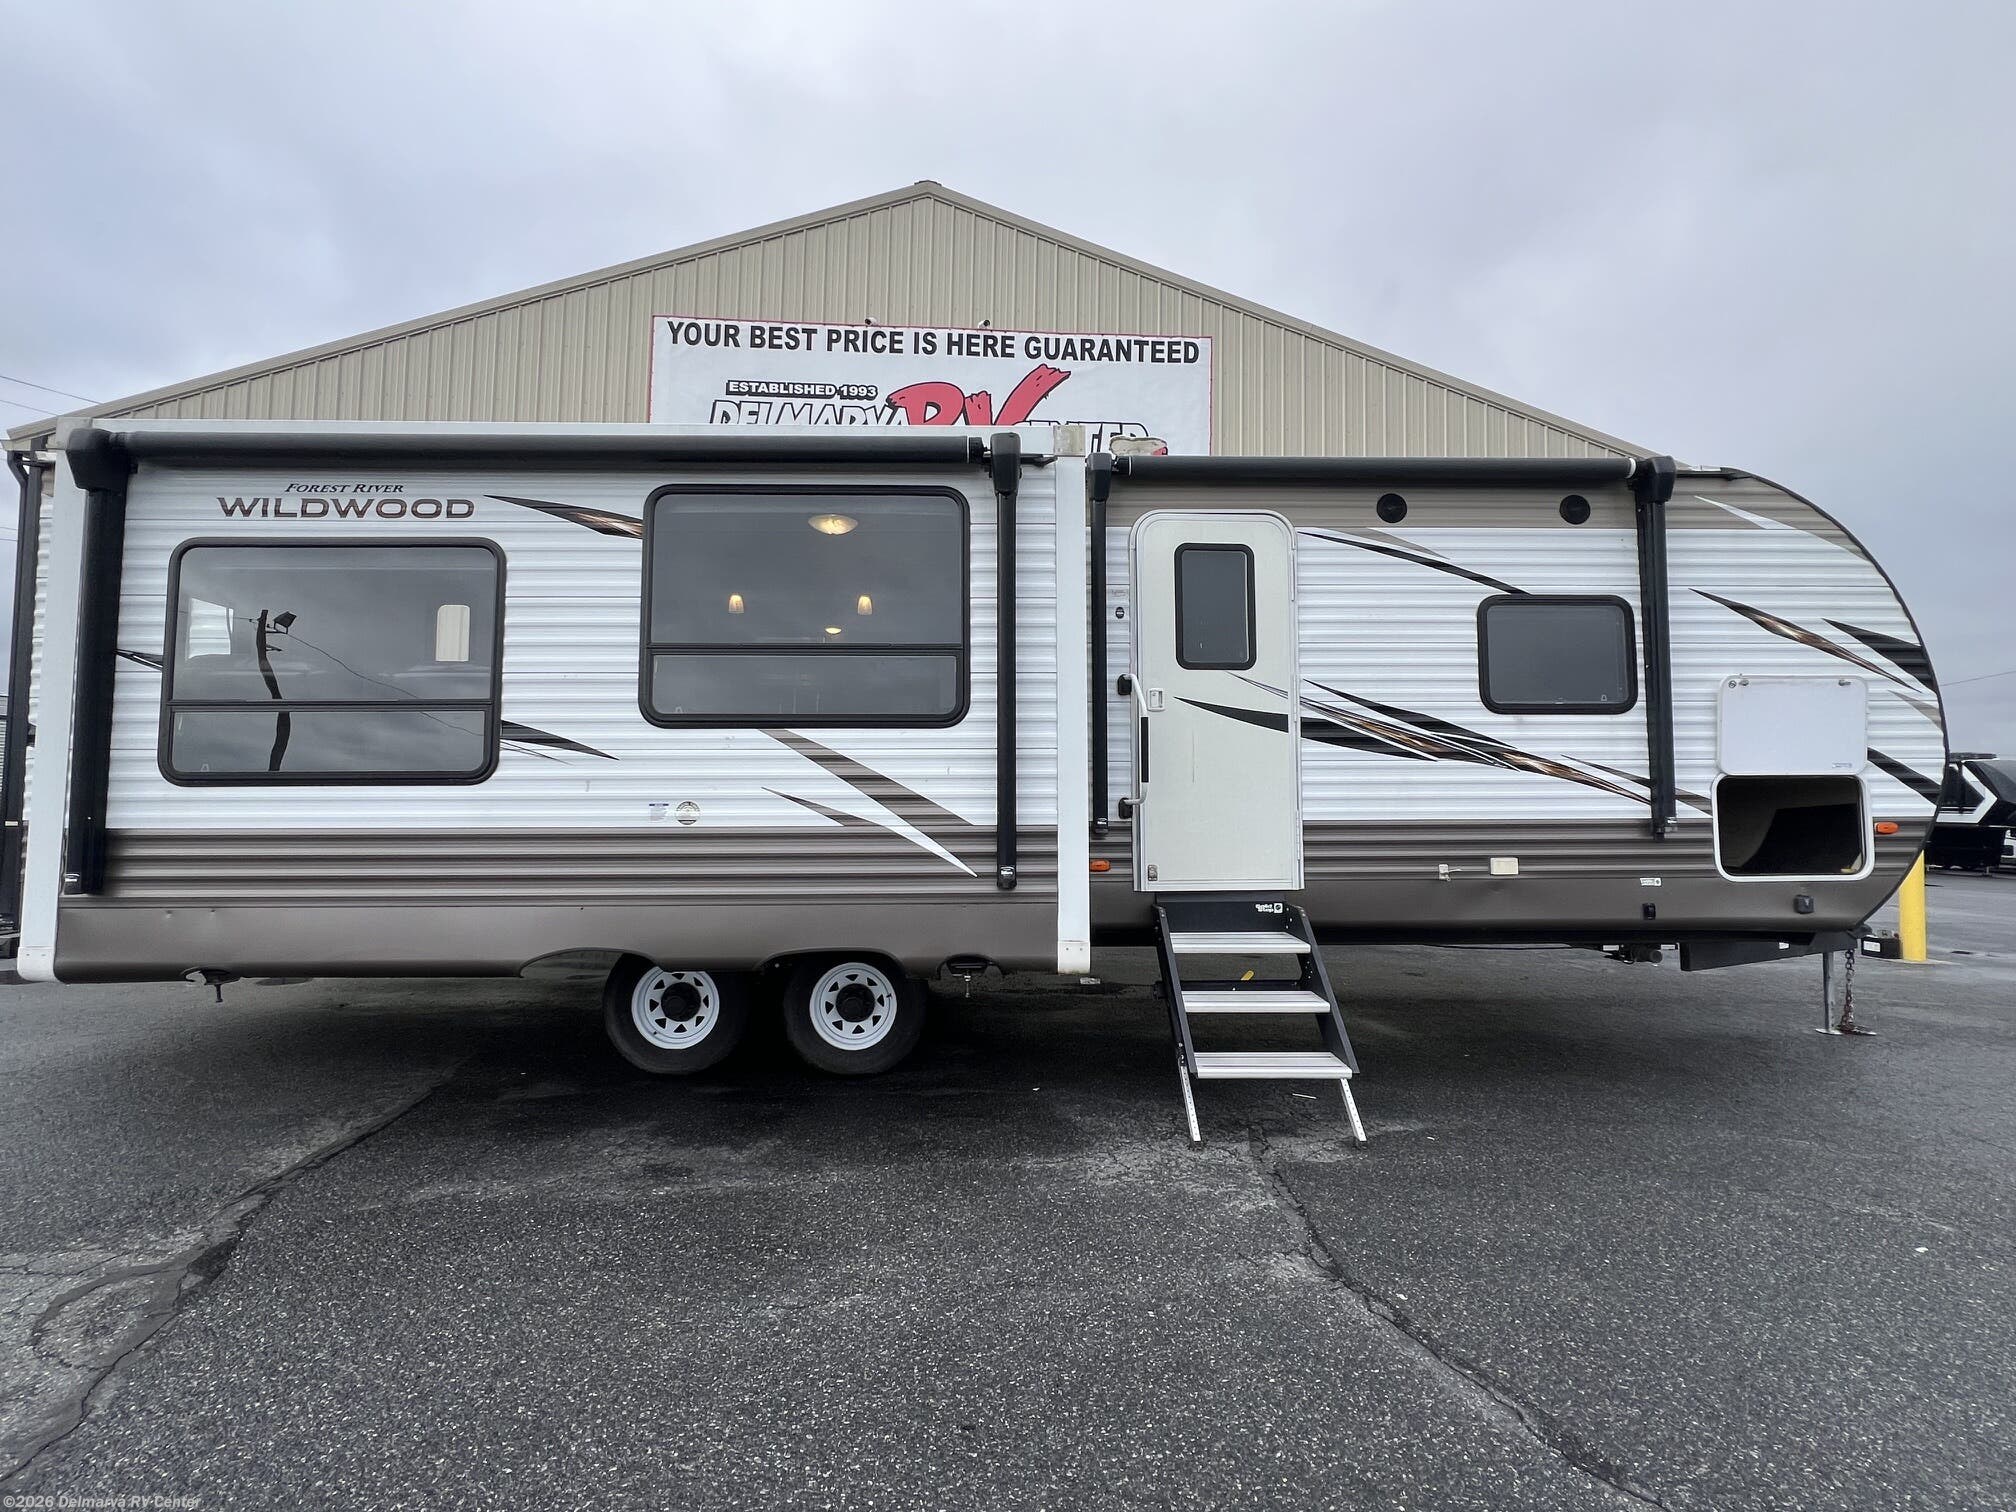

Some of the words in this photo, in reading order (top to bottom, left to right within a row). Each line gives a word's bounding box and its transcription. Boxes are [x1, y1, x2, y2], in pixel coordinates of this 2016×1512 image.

[667, 320, 741, 348] YOUR
[749, 325, 818, 352] BEST
[826, 328, 904, 354] PRICE
[913, 331, 938, 356] IS
[946, 332, 1016, 359] HERE
[1024, 336, 1200, 364] GUARANTEED
[728, 381, 837, 397] ESTABLISHED
[838, 384, 878, 399] 1993
[284, 483, 351, 494] FOREST
[352, 483, 405, 494] RIVER
[216, 497, 475, 519] WILDWOOD
